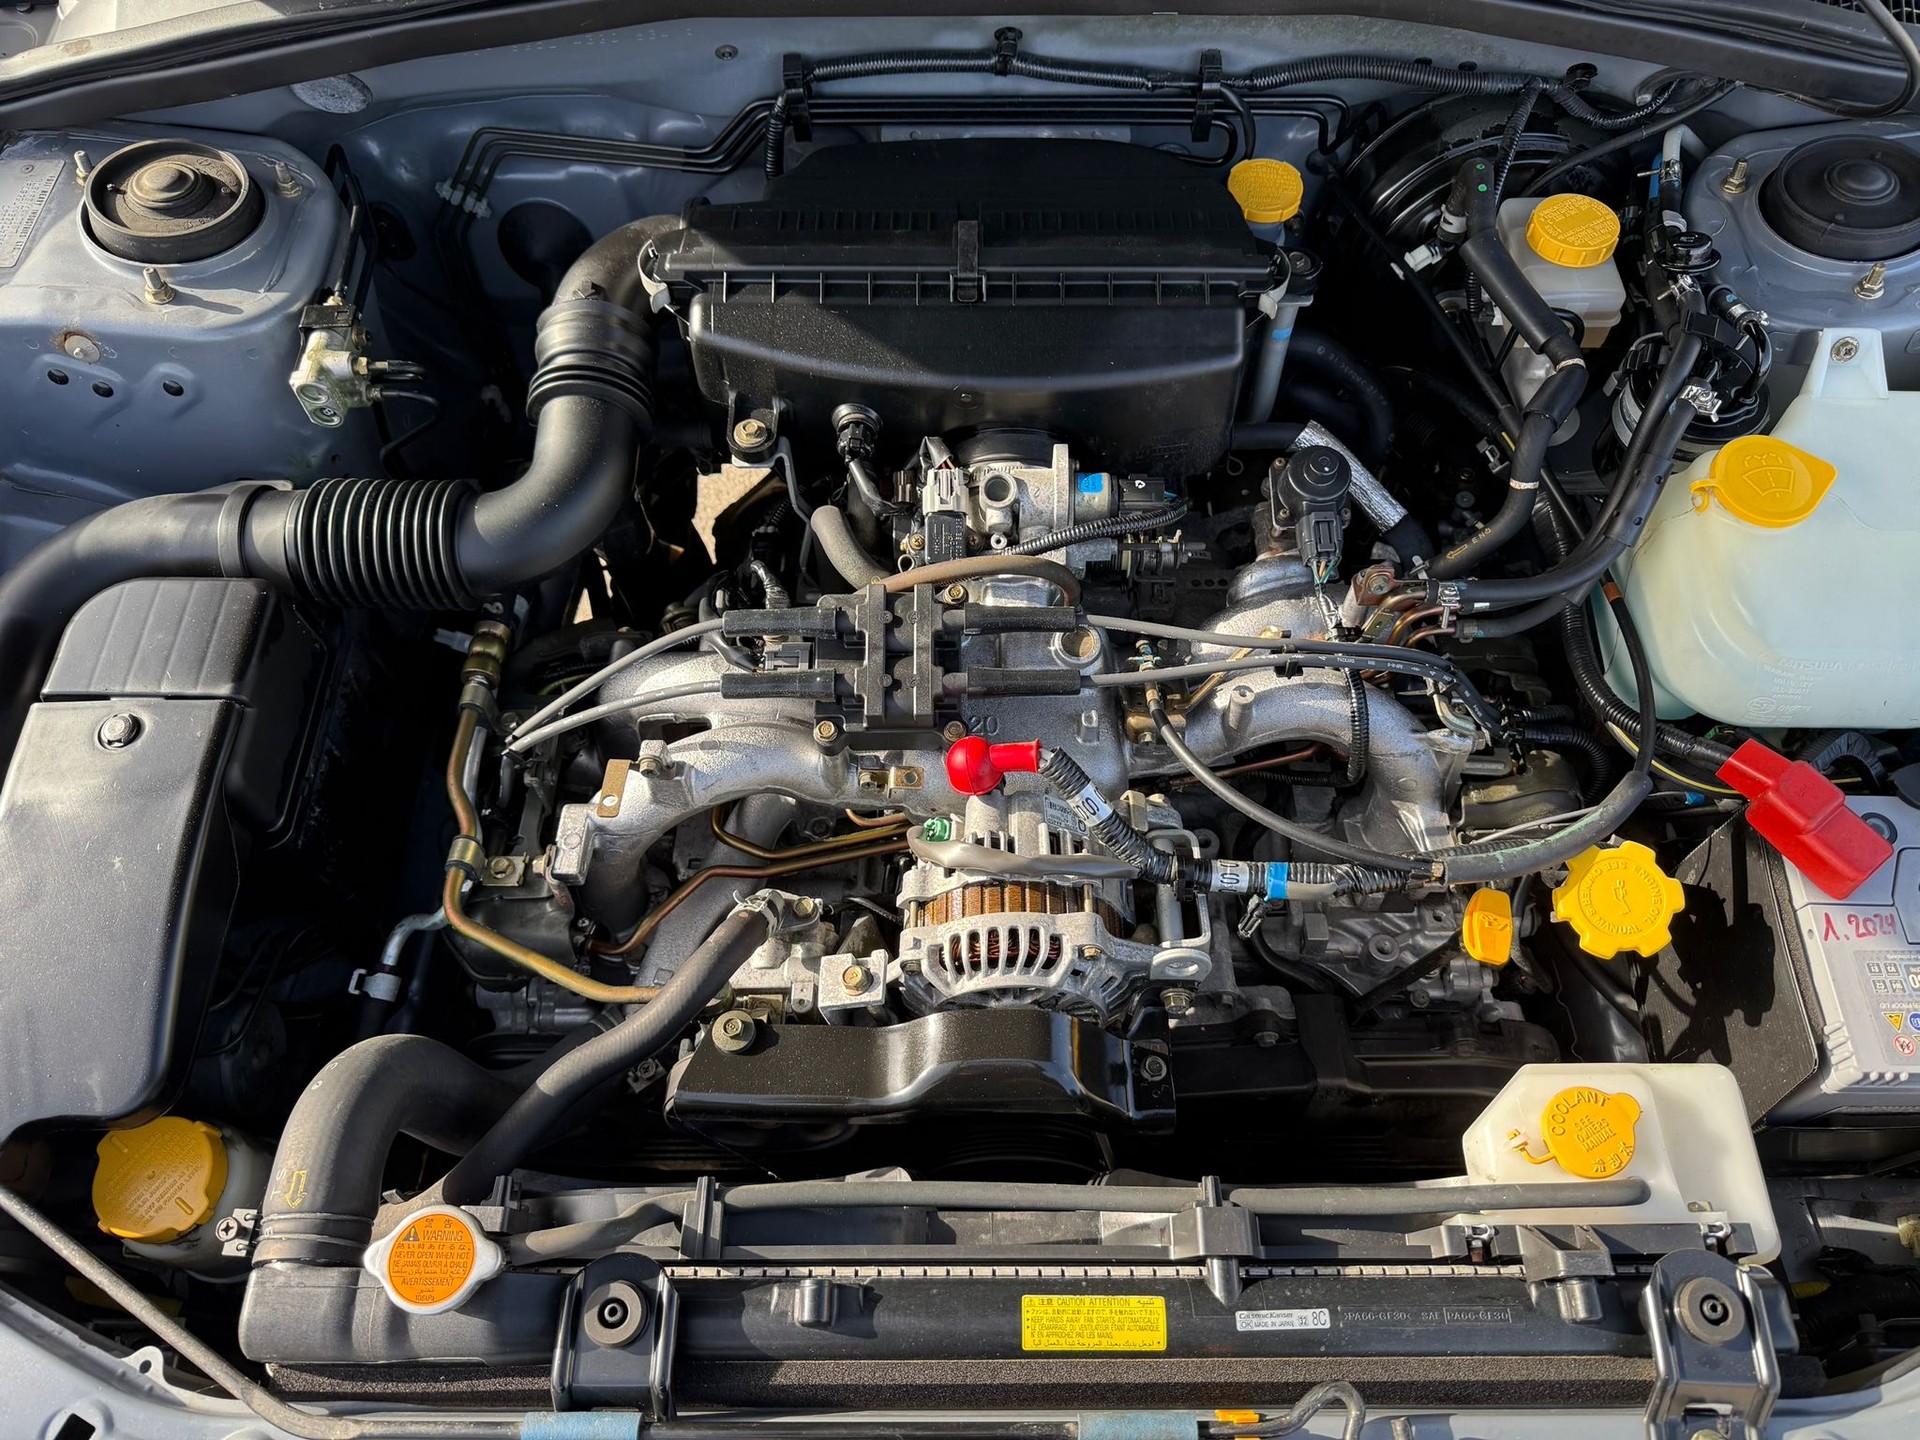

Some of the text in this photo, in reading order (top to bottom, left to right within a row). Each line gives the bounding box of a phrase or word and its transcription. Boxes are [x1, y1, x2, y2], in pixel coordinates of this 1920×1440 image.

[1632, 864, 1662, 925] ENGINE OIL
[1594, 913, 1643, 935] MANUAL
[1551, 1091, 1610, 1136] COOLANT
[1574, 1114, 1592, 1131] SEE
[1582, 1127, 1616, 1152] MANUAL
[423, 1229, 464, 1241] WARNING
[394, 1251, 415, 1259] NEVER
[416, 1251, 434, 1259] OPEN
[435, 1251, 455, 1260] WHEN
[401, 1278, 455, 1286] AVERTISSEMENT
[1056, 1298, 1131, 1307] CAUTION ATTENTION
[1096, 1316, 1116, 1324] STARTS
[1254, 1320, 1269, 1328] MADE
[1311, 1310, 1327, 1326] 8C
[1075, 1331, 1085, 1339] PAS
